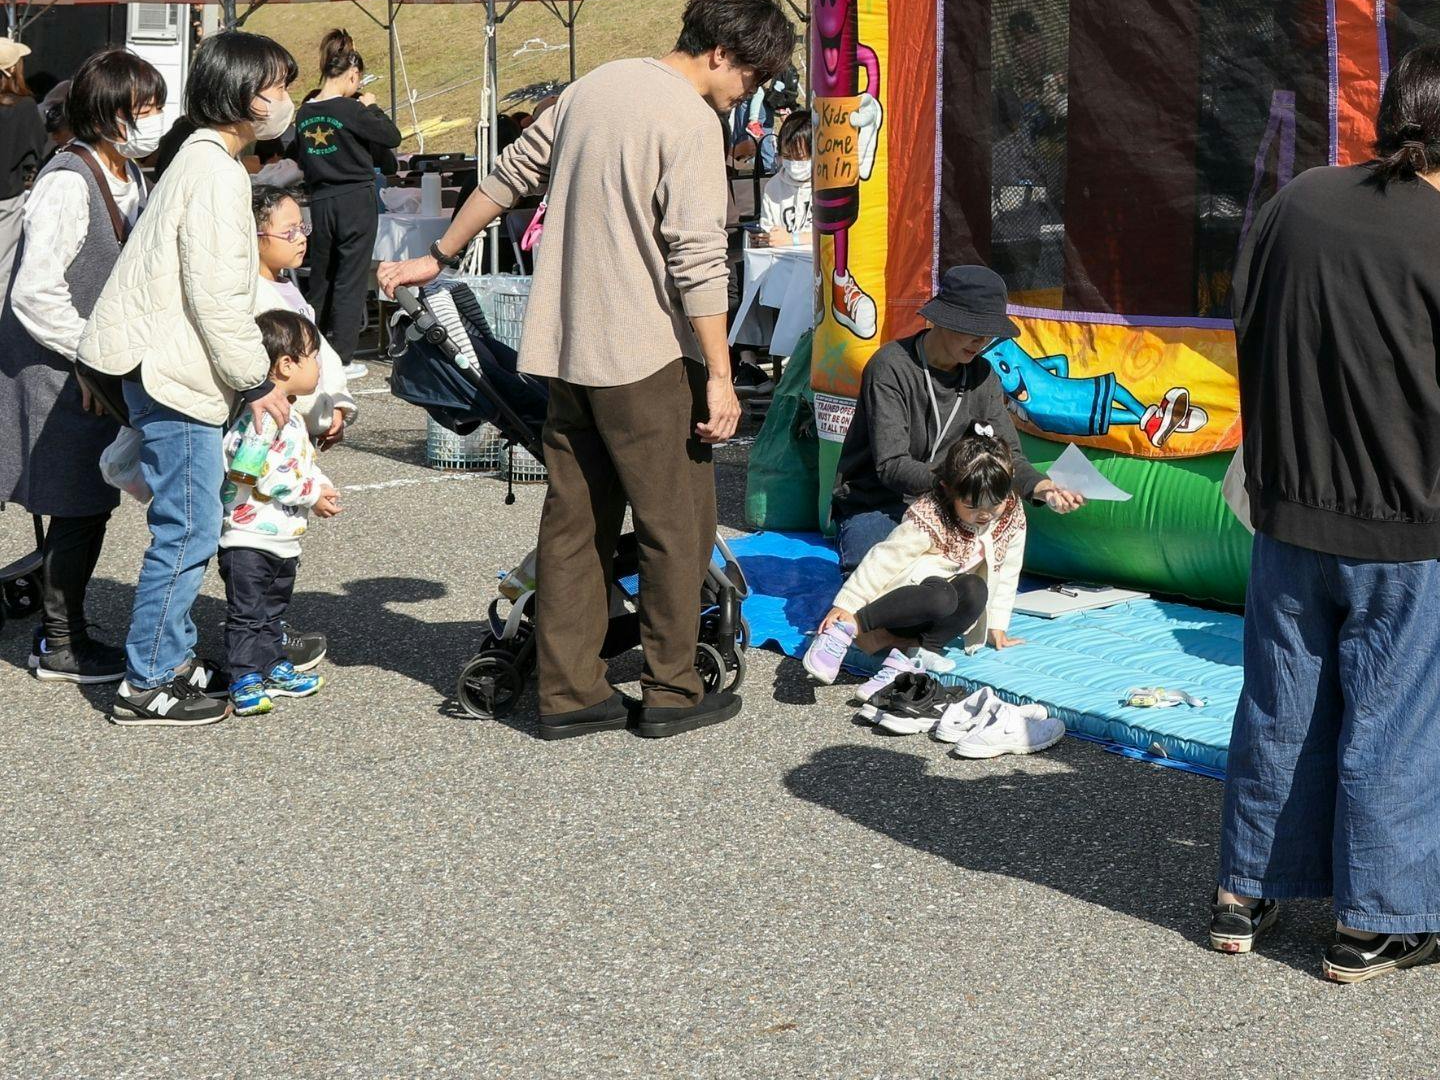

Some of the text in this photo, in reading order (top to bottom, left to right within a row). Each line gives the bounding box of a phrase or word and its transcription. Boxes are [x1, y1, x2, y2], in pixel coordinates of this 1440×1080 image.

[822, 102, 848, 127] Kids
[817, 131, 853, 155] Come
[817, 157, 852, 180] on in
[189, 667, 213, 688] N
[146, 692, 179, 716] N
